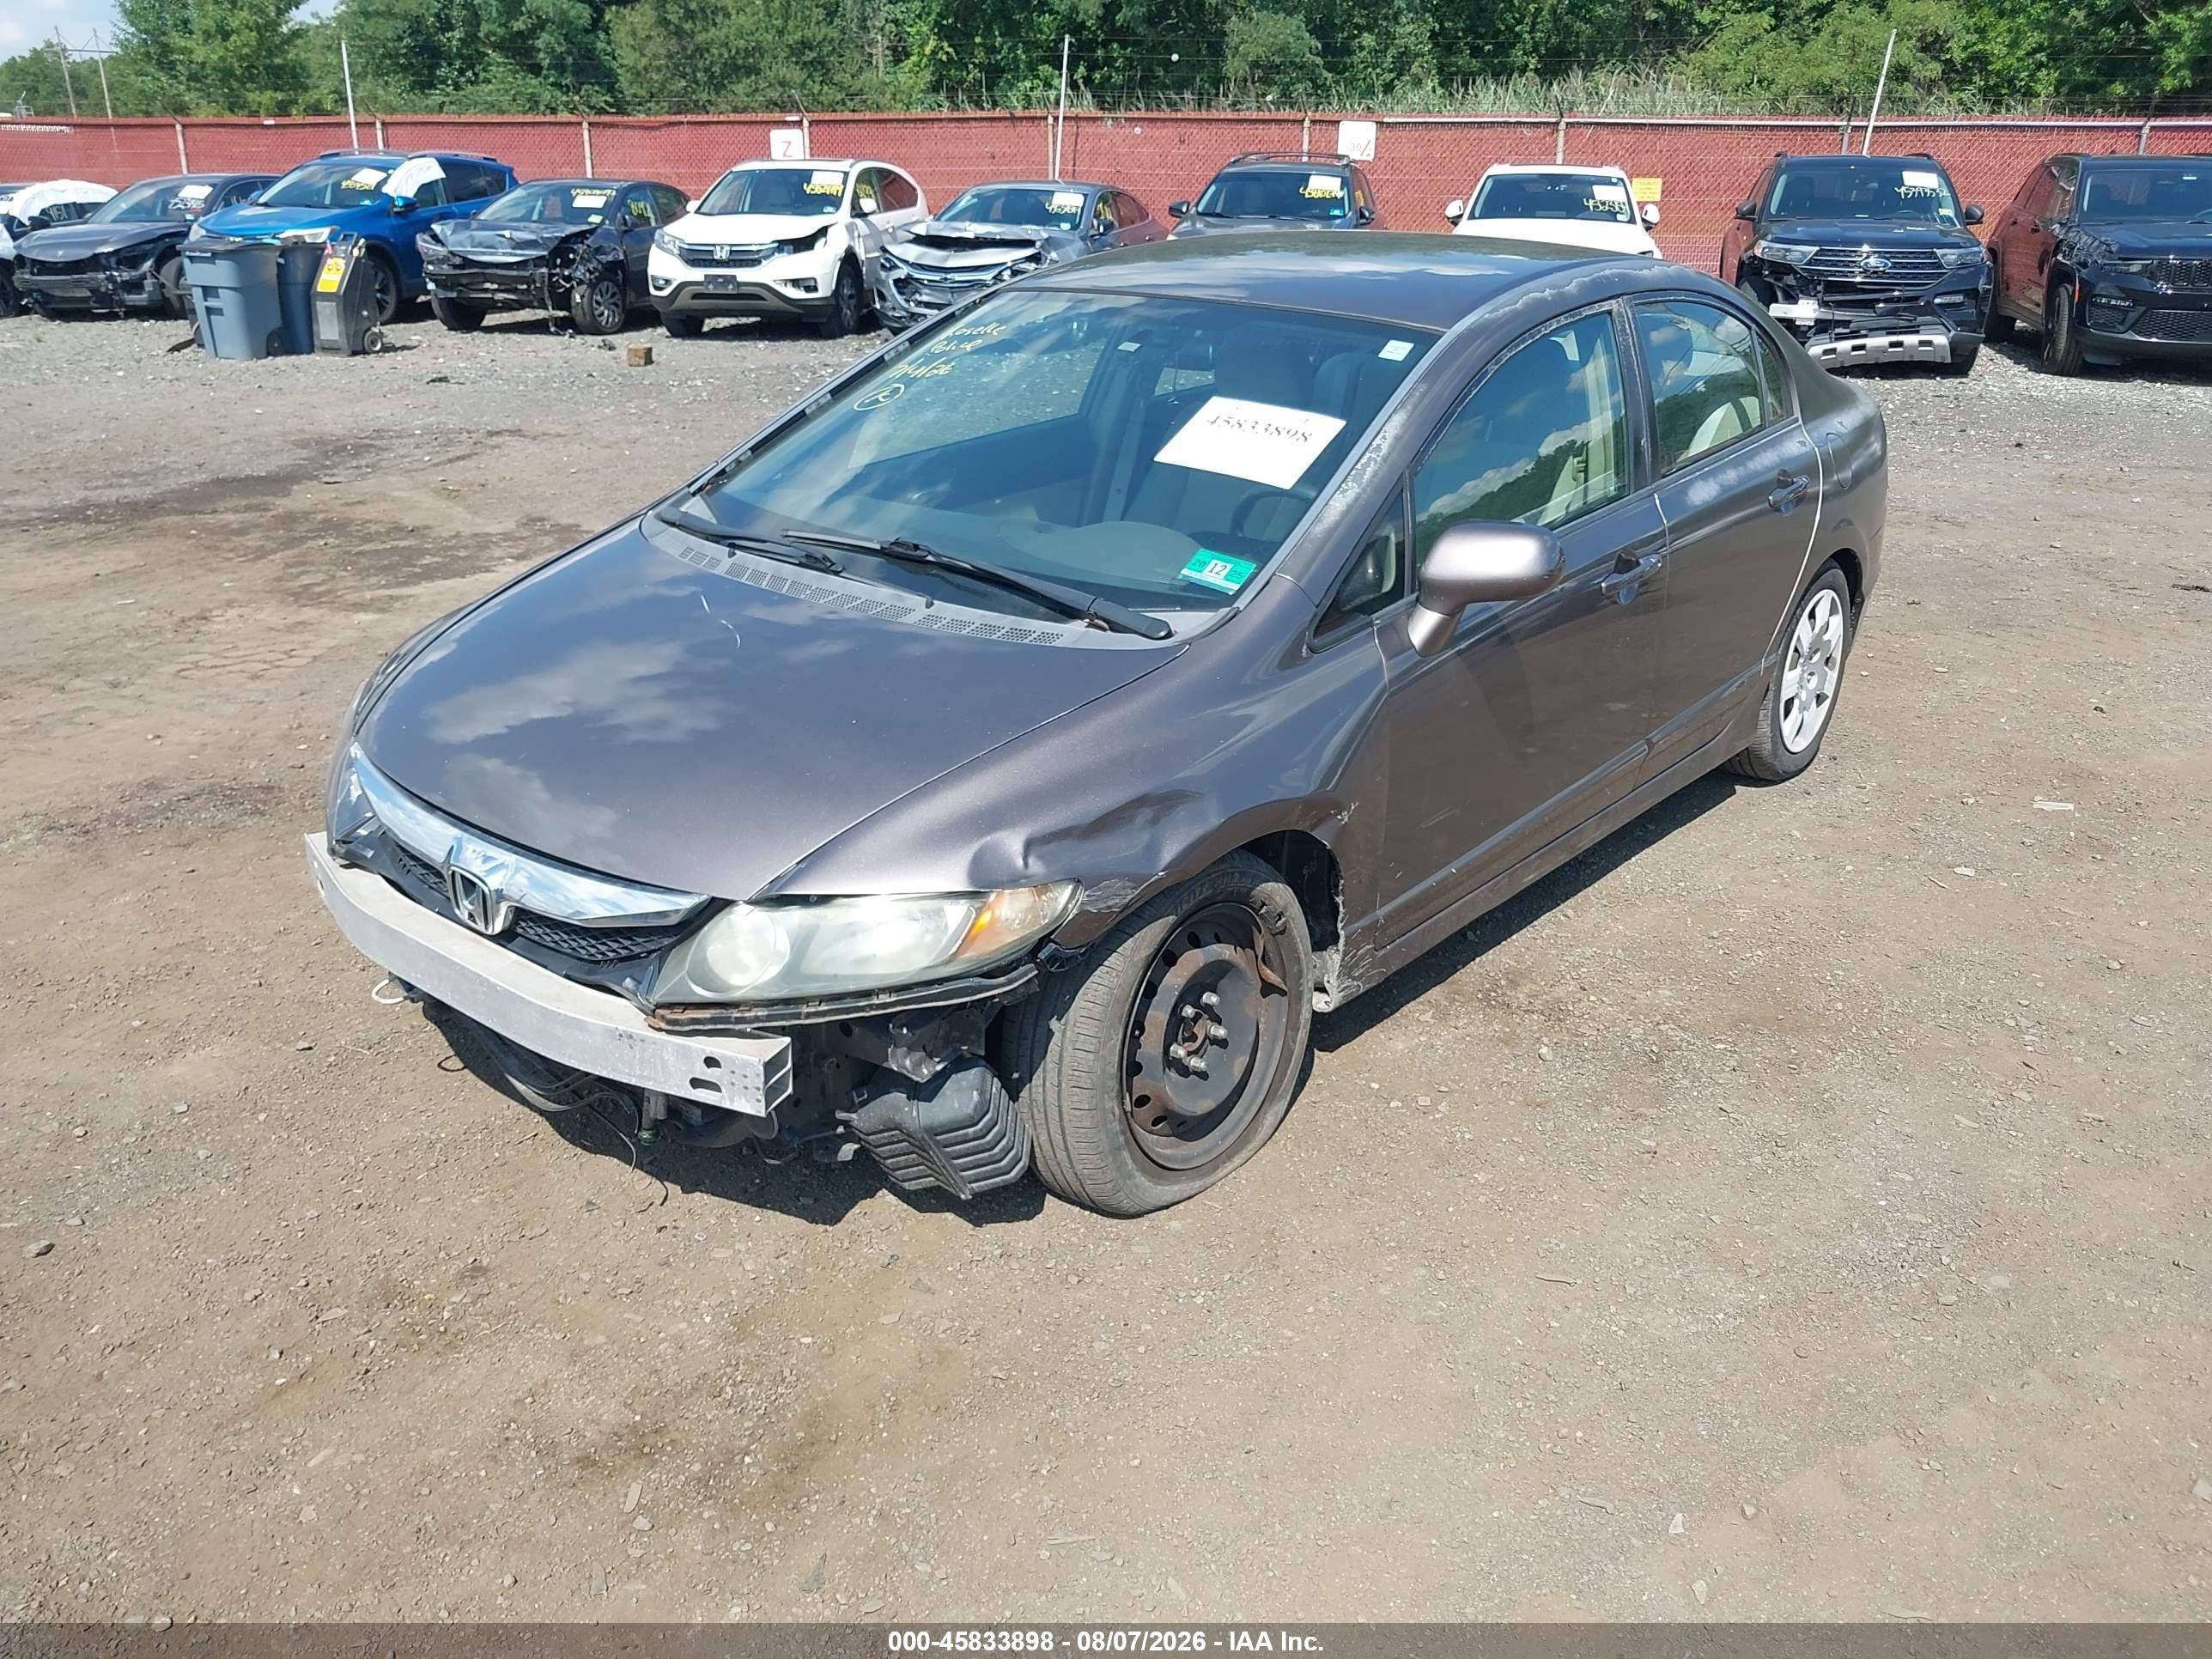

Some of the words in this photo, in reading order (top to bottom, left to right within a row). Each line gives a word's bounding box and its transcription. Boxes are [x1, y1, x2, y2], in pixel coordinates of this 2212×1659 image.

[1192, 558, 1206, 568] 20
[1207, 562, 1227, 575] 12
[1229, 570, 1244, 580] 25
